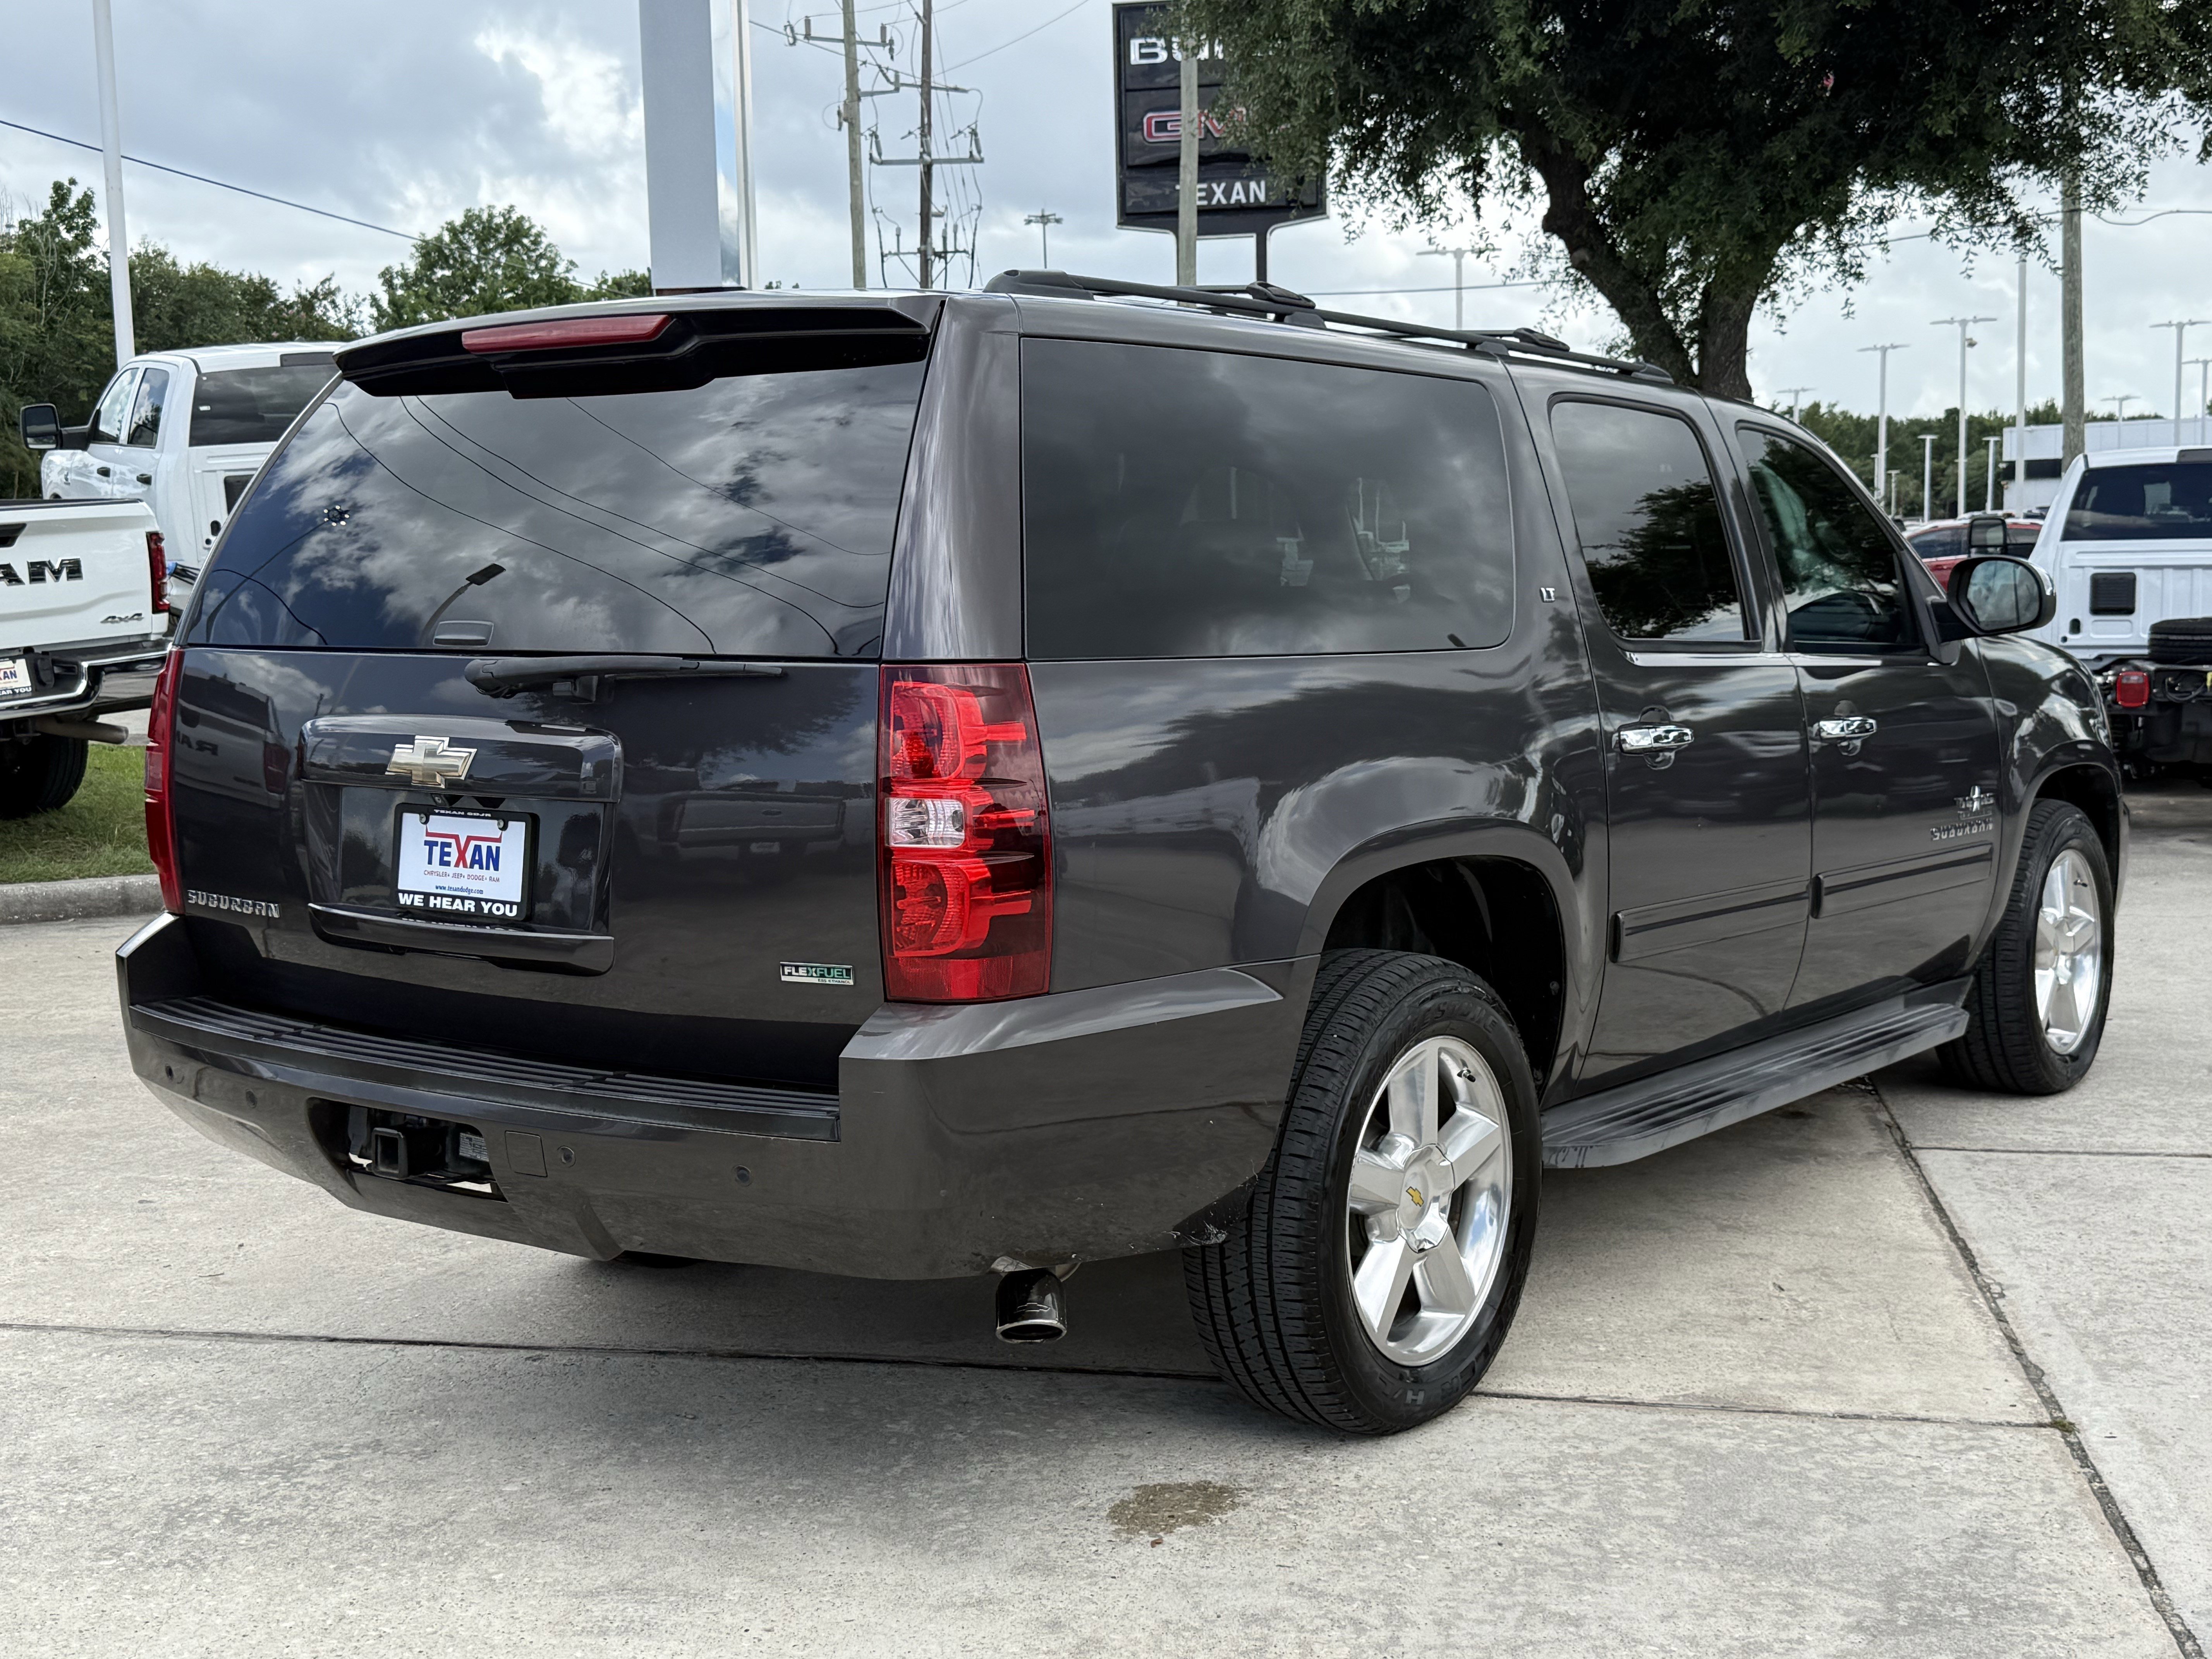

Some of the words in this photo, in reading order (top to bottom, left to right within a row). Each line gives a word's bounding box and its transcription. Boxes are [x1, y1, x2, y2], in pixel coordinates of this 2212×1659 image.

[1175, 180, 1267, 206] EXAN
[1539, 587, 1555, 603] LT
[424, 830, 502, 871] TEXAN
[187, 890, 280, 918] SUBURBAN
[398, 893, 424, 907] WE
[429, 896, 475, 912] HEAR
[481, 901, 517, 917] YOU
[784, 966, 850, 978] FLEXFUEL
